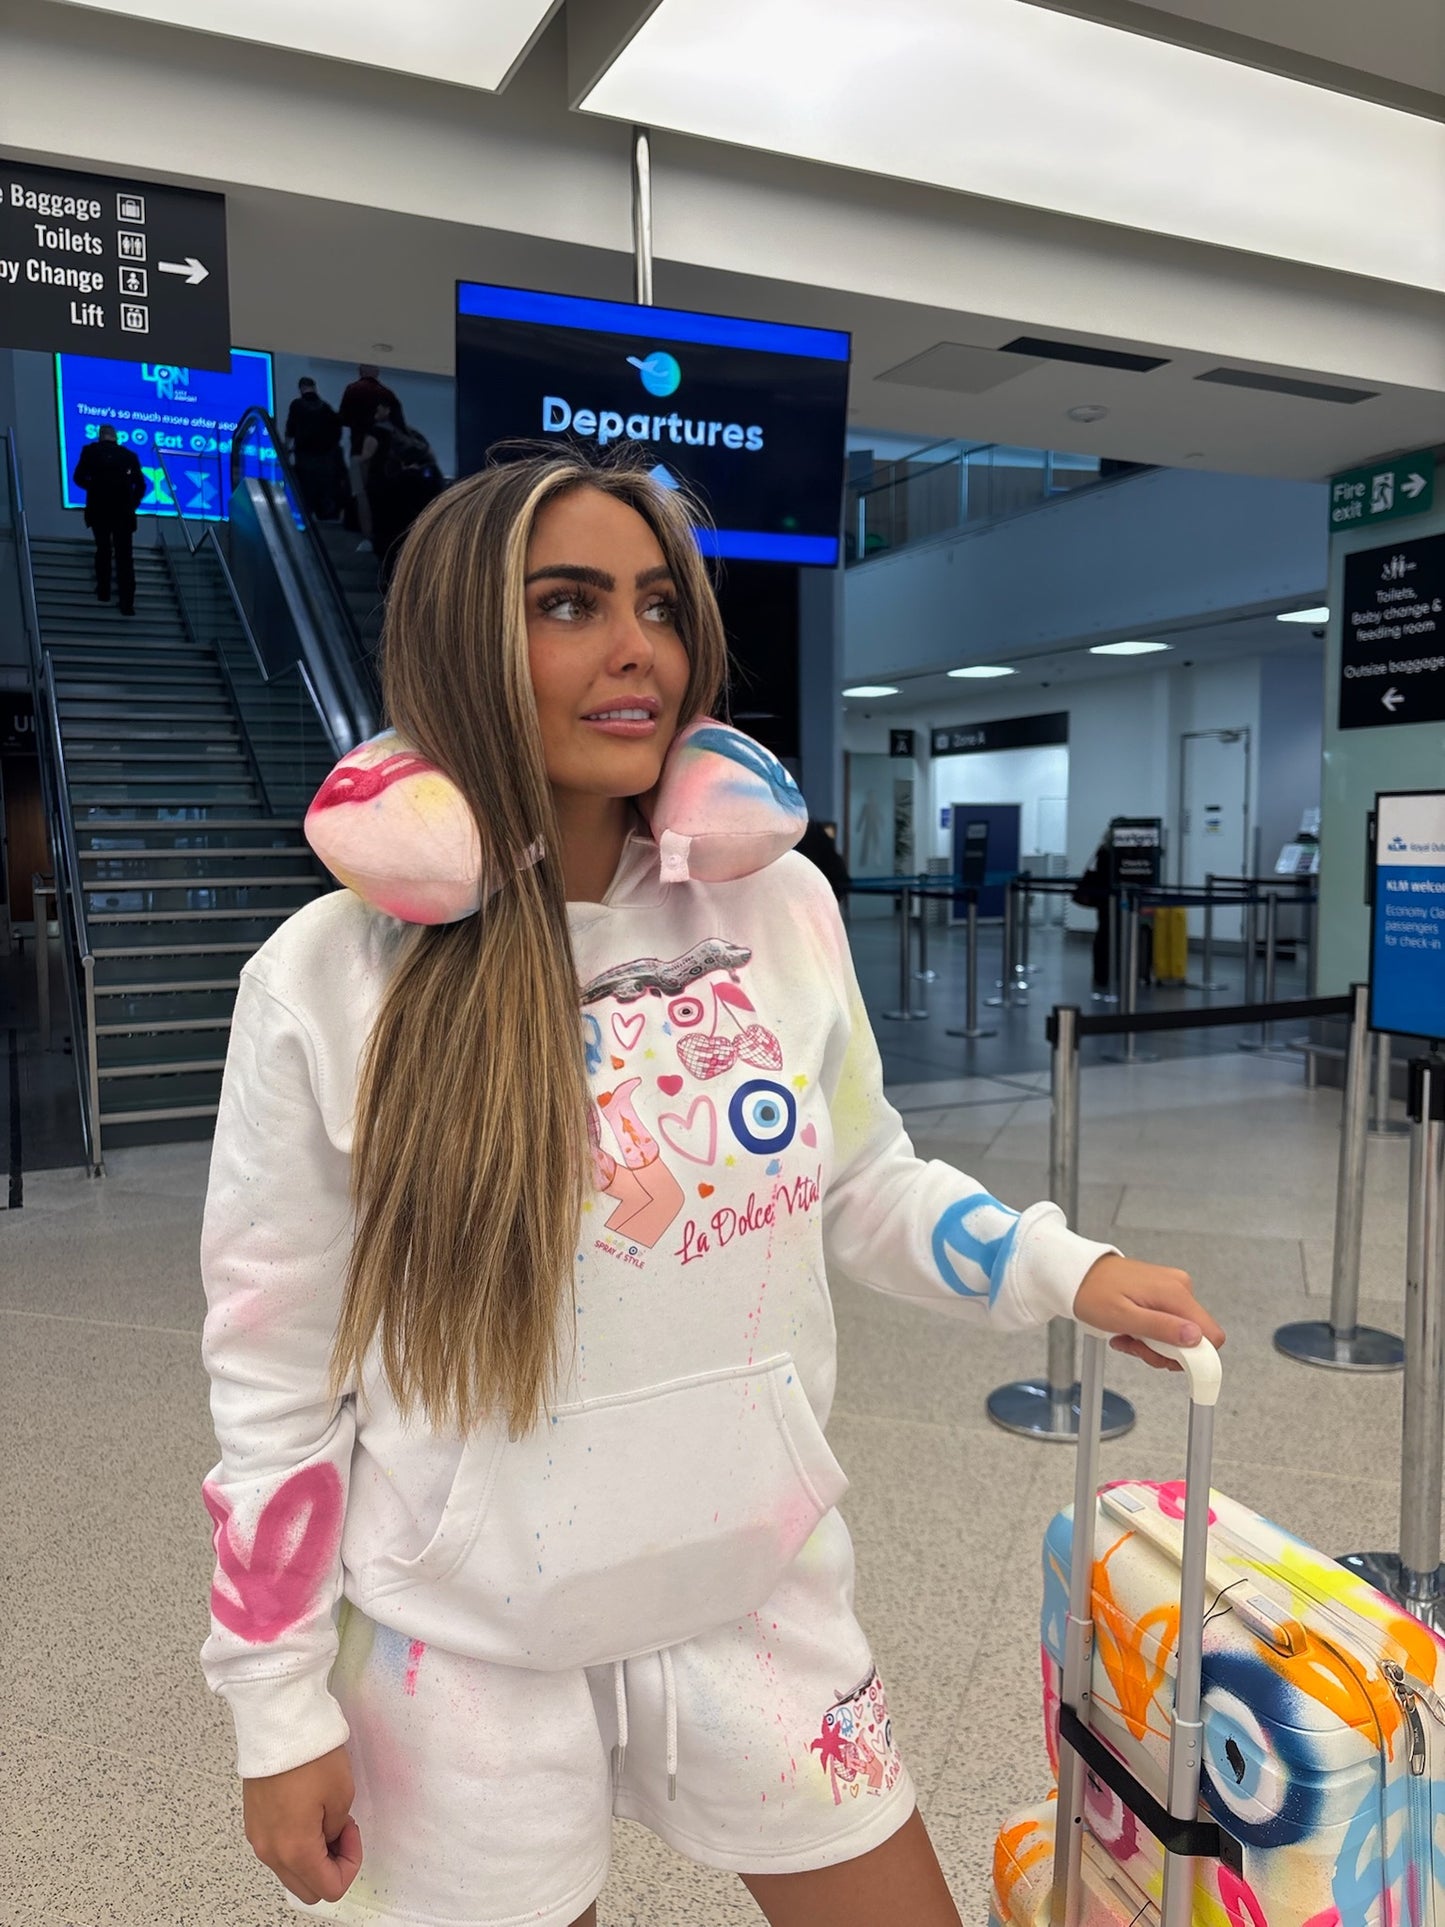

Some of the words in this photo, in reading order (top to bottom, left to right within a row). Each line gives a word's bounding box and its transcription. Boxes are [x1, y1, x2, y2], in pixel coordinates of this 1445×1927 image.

[11, 183, 101, 221] Baggage
[34, 224, 103, 255] Toilets
[26, 258, 104, 293] Change
[70, 301, 104, 327] Lift
[117, 409, 131, 419] so
[132, 411, 161, 422] much
[542, 396, 764, 451] Departures
[85, 423, 129, 445] Sp
[155, 431, 183, 448] Eat
[1333, 482, 1366, 502] Fire
[1332, 501, 1362, 522] exit
[1352, 610, 1382, 626] Baby
[1383, 603, 1430, 620] change
[1431, 598, 1443, 612] &
[1356, 626, 1402, 642] feeding
[1403, 621, 1436, 635] room
[1344, 664, 1388, 678] Outsize
[1388, 656, 1445, 675] baggage
[1386, 879, 1408, 892] KLM
[1385, 904, 1428, 919] Economy
[1385, 921, 1439, 936] passengers
[1400, 937, 1441, 950] check-in
[674, 1220, 710, 1265] La
[711, 1192, 775, 1246] Dolce
[594, 1240, 616, 1255] SPRAY
[624, 1254, 645, 1269] STYLE
